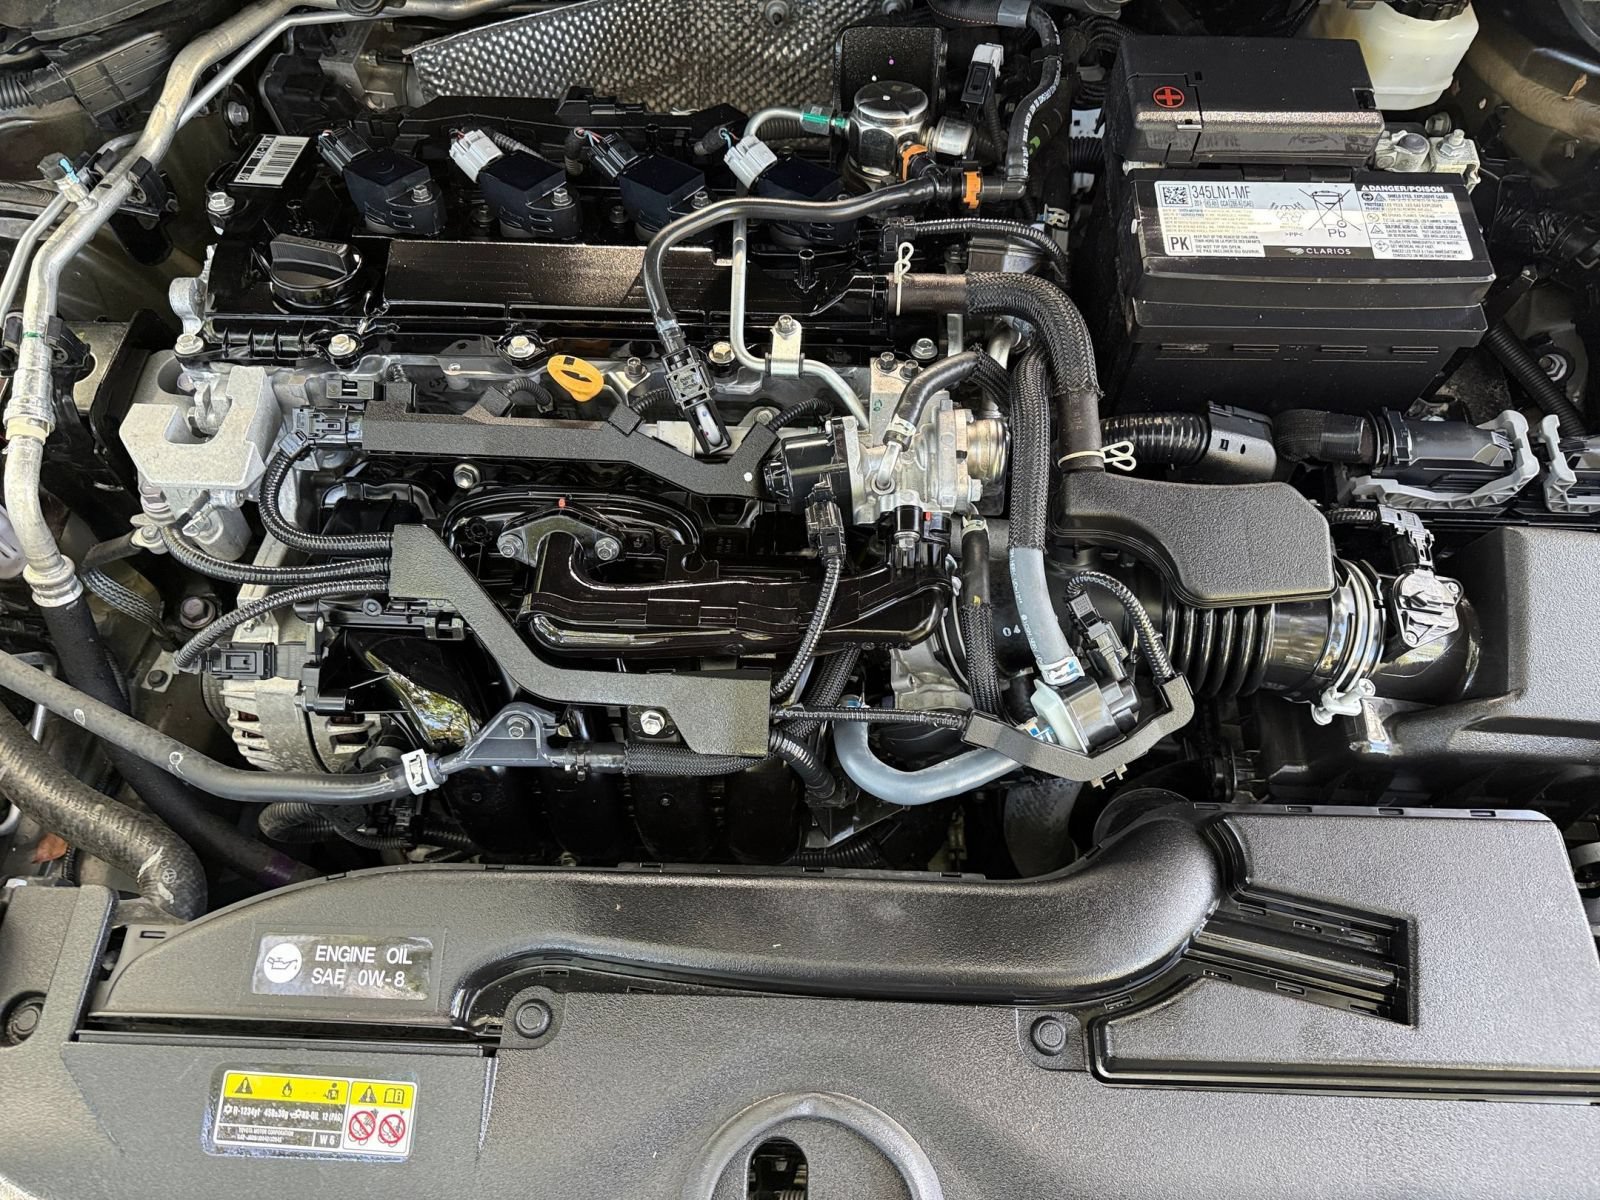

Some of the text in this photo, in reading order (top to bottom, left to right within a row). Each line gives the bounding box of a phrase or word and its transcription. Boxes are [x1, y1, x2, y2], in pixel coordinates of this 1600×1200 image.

[1192, 185, 1251, 200] 345LN1-MF
[1328, 229, 1346, 238] Pb
[1170, 236, 1190, 250] PK
[1306, 247, 1351, 255] CLARIOS
[315, 945, 413, 965] ENGINE OIL
[311, 967, 405, 987] SAE 0W-8
